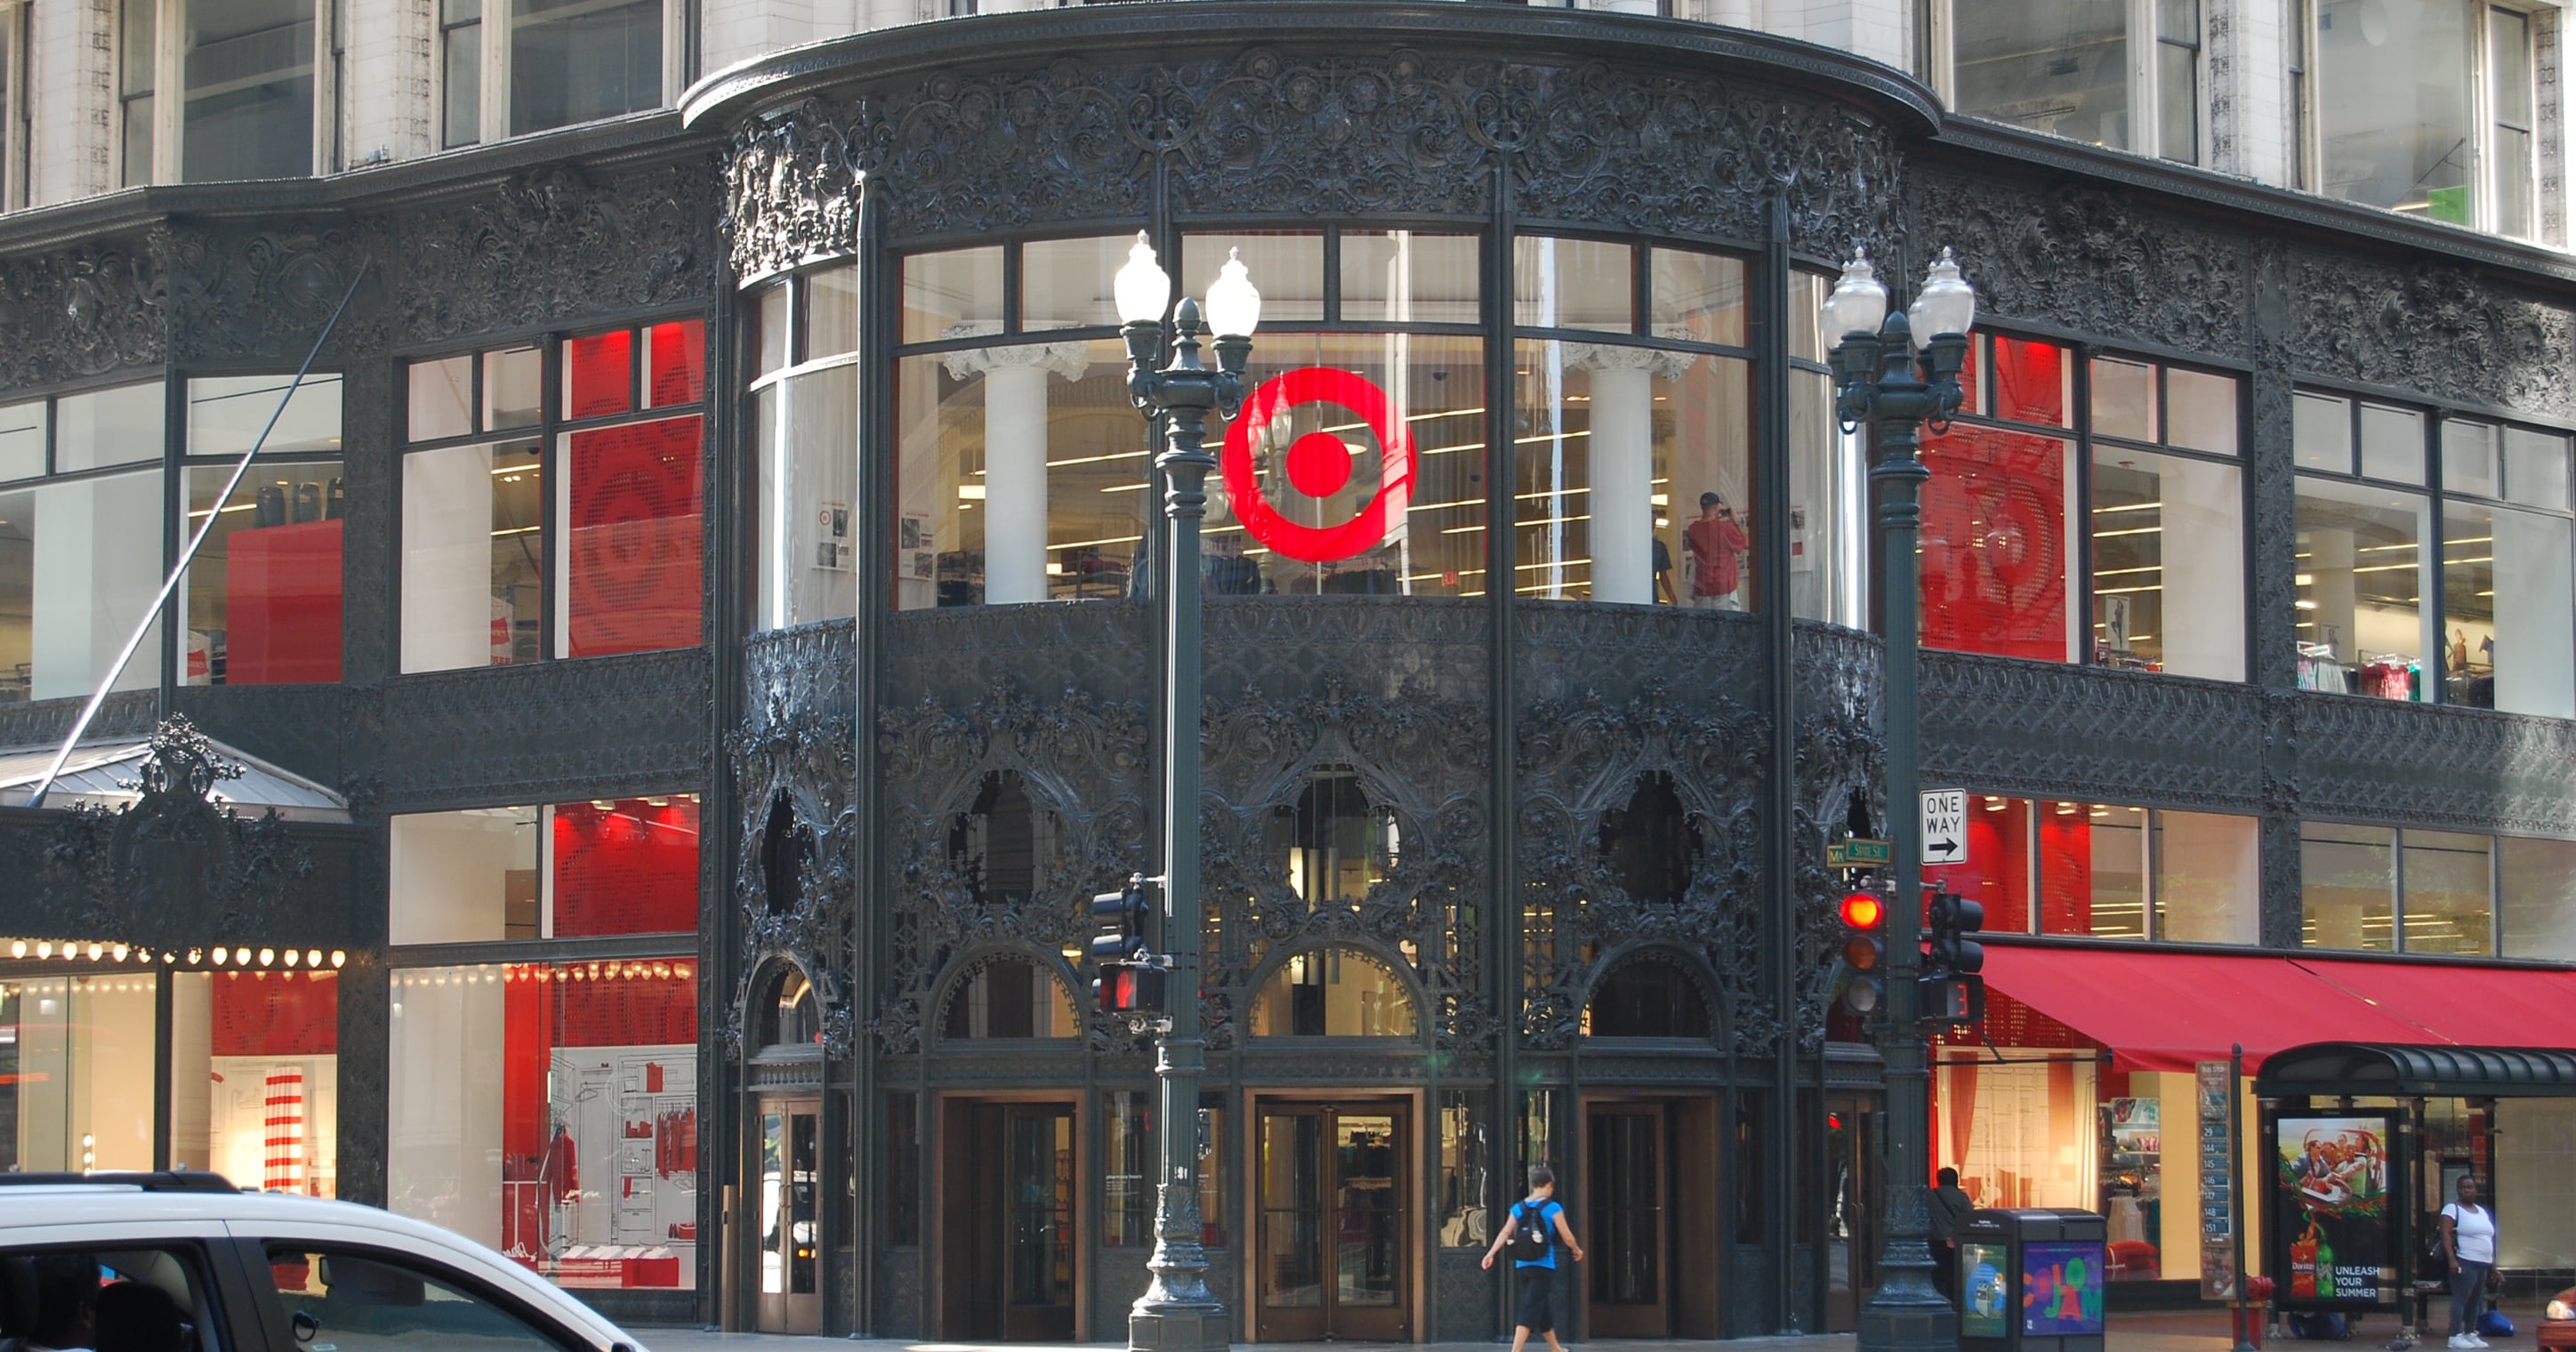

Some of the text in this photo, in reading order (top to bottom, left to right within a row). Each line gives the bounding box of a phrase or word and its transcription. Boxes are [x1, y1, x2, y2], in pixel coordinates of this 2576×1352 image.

[1927, 797, 1960, 814] ONE
[1927, 817, 1960, 833] WAY
[2204, 1128, 2213, 1137] 29
[2203, 1144, 2215, 1152] 144
[2204, 1160, 2215, 1169] 145
[2205, 1208, 2216, 1217] 148
[2206, 1224, 2216, 1233] 151
[2335, 1266, 2380, 1276] UNLEASH
[2335, 1276, 2363, 1286] YOUR
[2335, 1288, 2376, 1298] SUMMER
